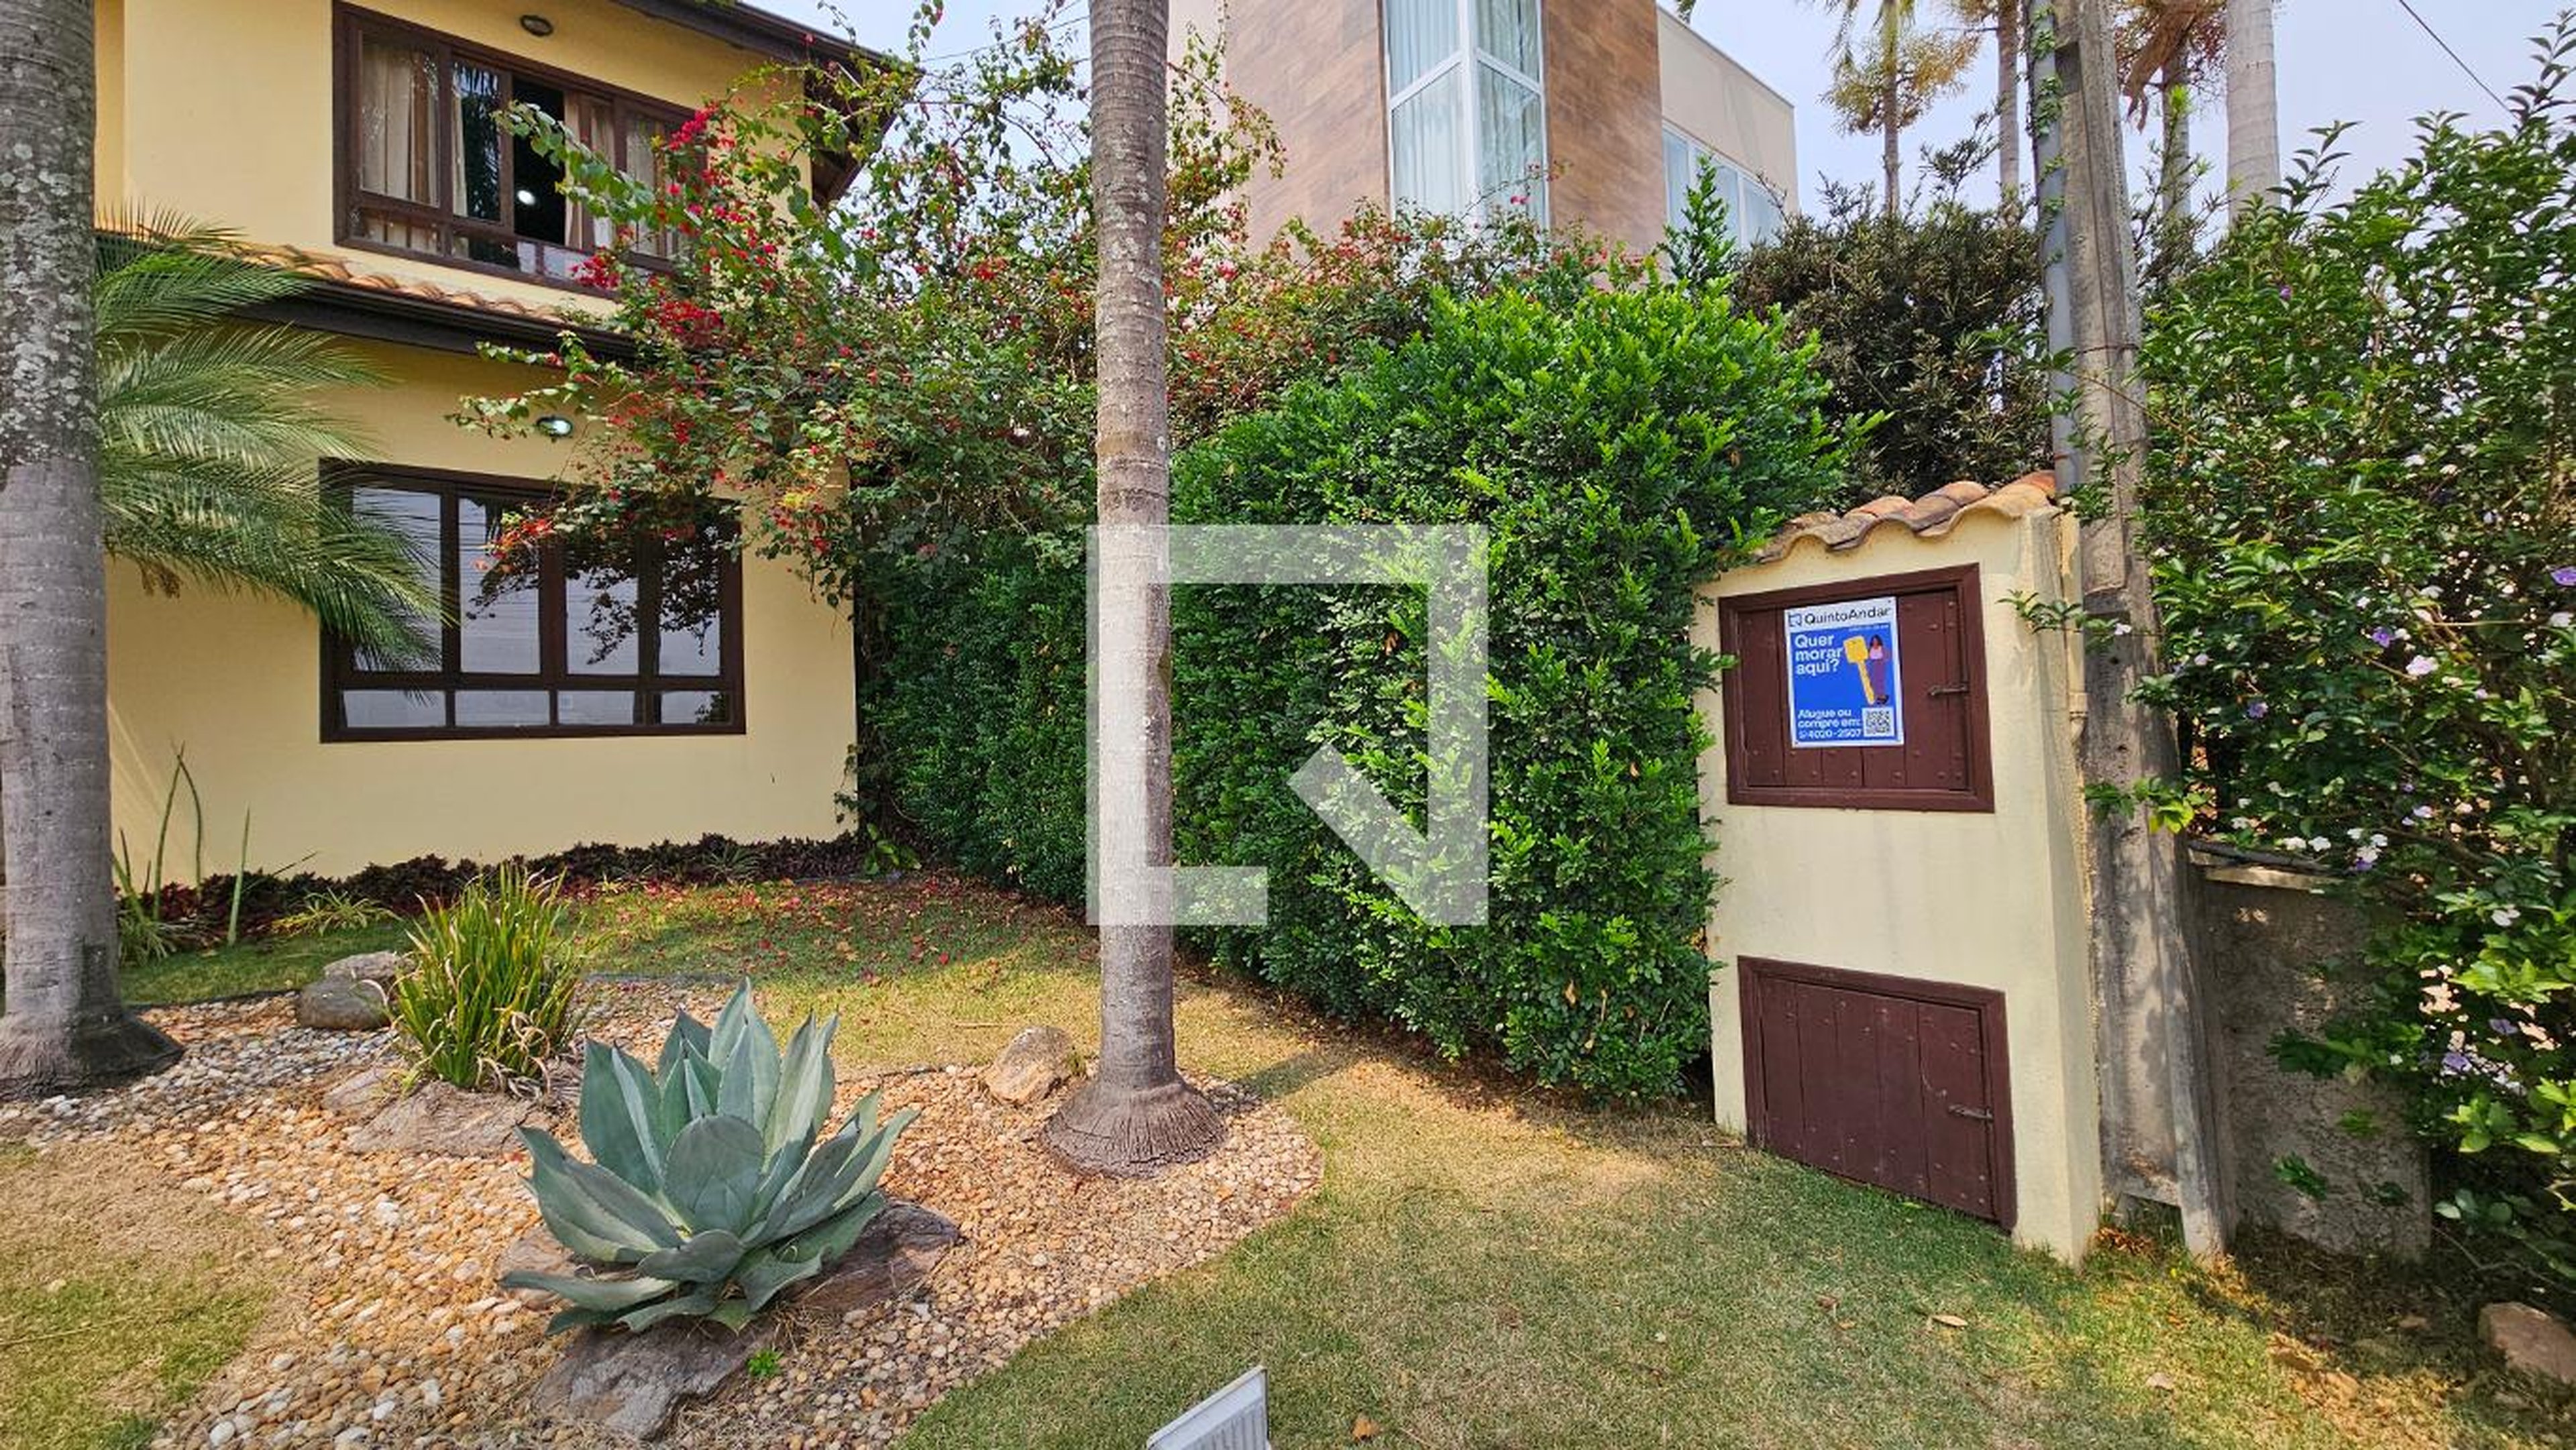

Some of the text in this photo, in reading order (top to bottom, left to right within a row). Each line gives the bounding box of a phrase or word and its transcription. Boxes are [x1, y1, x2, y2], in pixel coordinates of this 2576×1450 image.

[1805, 606, 1891, 624] QuintoAndar
[1795, 634, 1834, 649] Quer
[1795, 647, 1843, 661] morar
[1796, 659, 1839, 677] aqui?
[1837, 709, 1851, 717] ou
